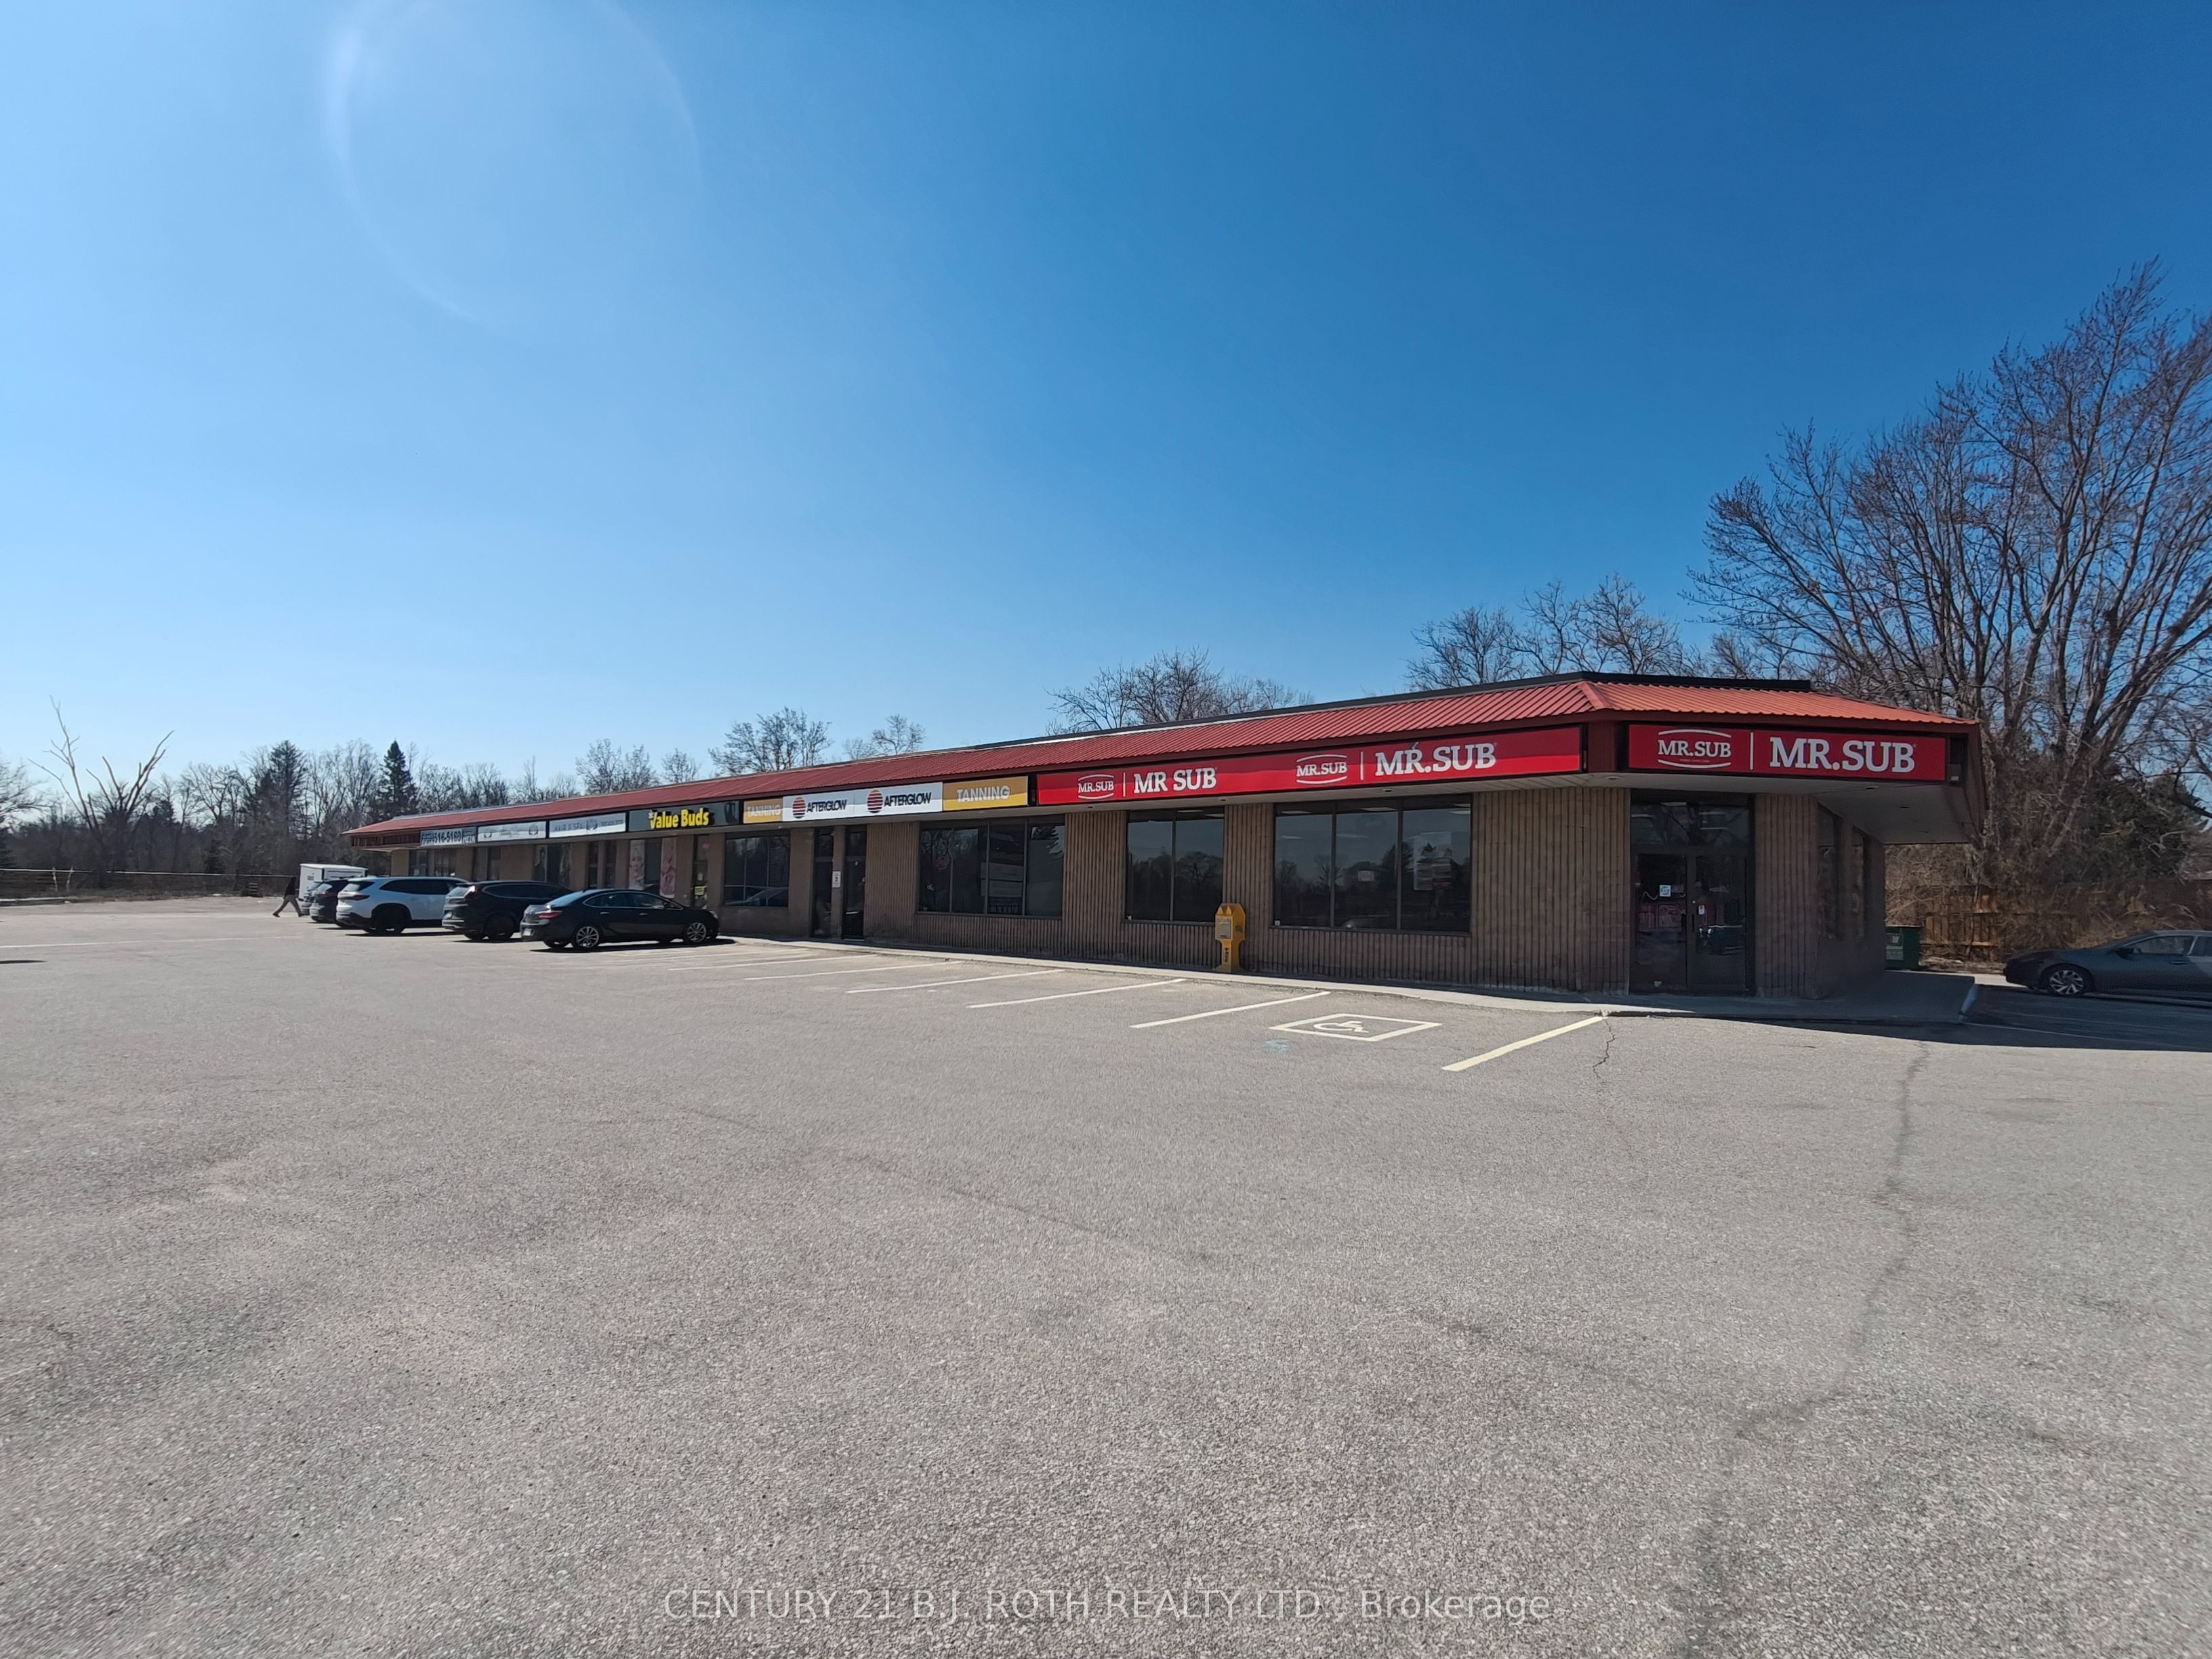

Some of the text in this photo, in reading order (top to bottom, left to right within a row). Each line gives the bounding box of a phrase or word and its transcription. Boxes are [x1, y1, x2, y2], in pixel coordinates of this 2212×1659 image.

[1658, 739, 1732, 758] MR.SUB
[1769, 737, 1915, 773] MR.SUB
[1375, 743, 1496, 776] MR.SUB
[1296, 761, 1348, 777] MR.SUB
[1078, 780, 1114, 793] MR.SUB
[1133, 767, 1217, 794] MR SUB
[884, 792, 932, 807] AFTERGLOW
[957, 785, 1010, 803] TANNING
[747, 804, 781, 817] TANNING
[806, 800, 847, 813] AFTERGLOW
[649, 808, 709, 829] Value Buds
